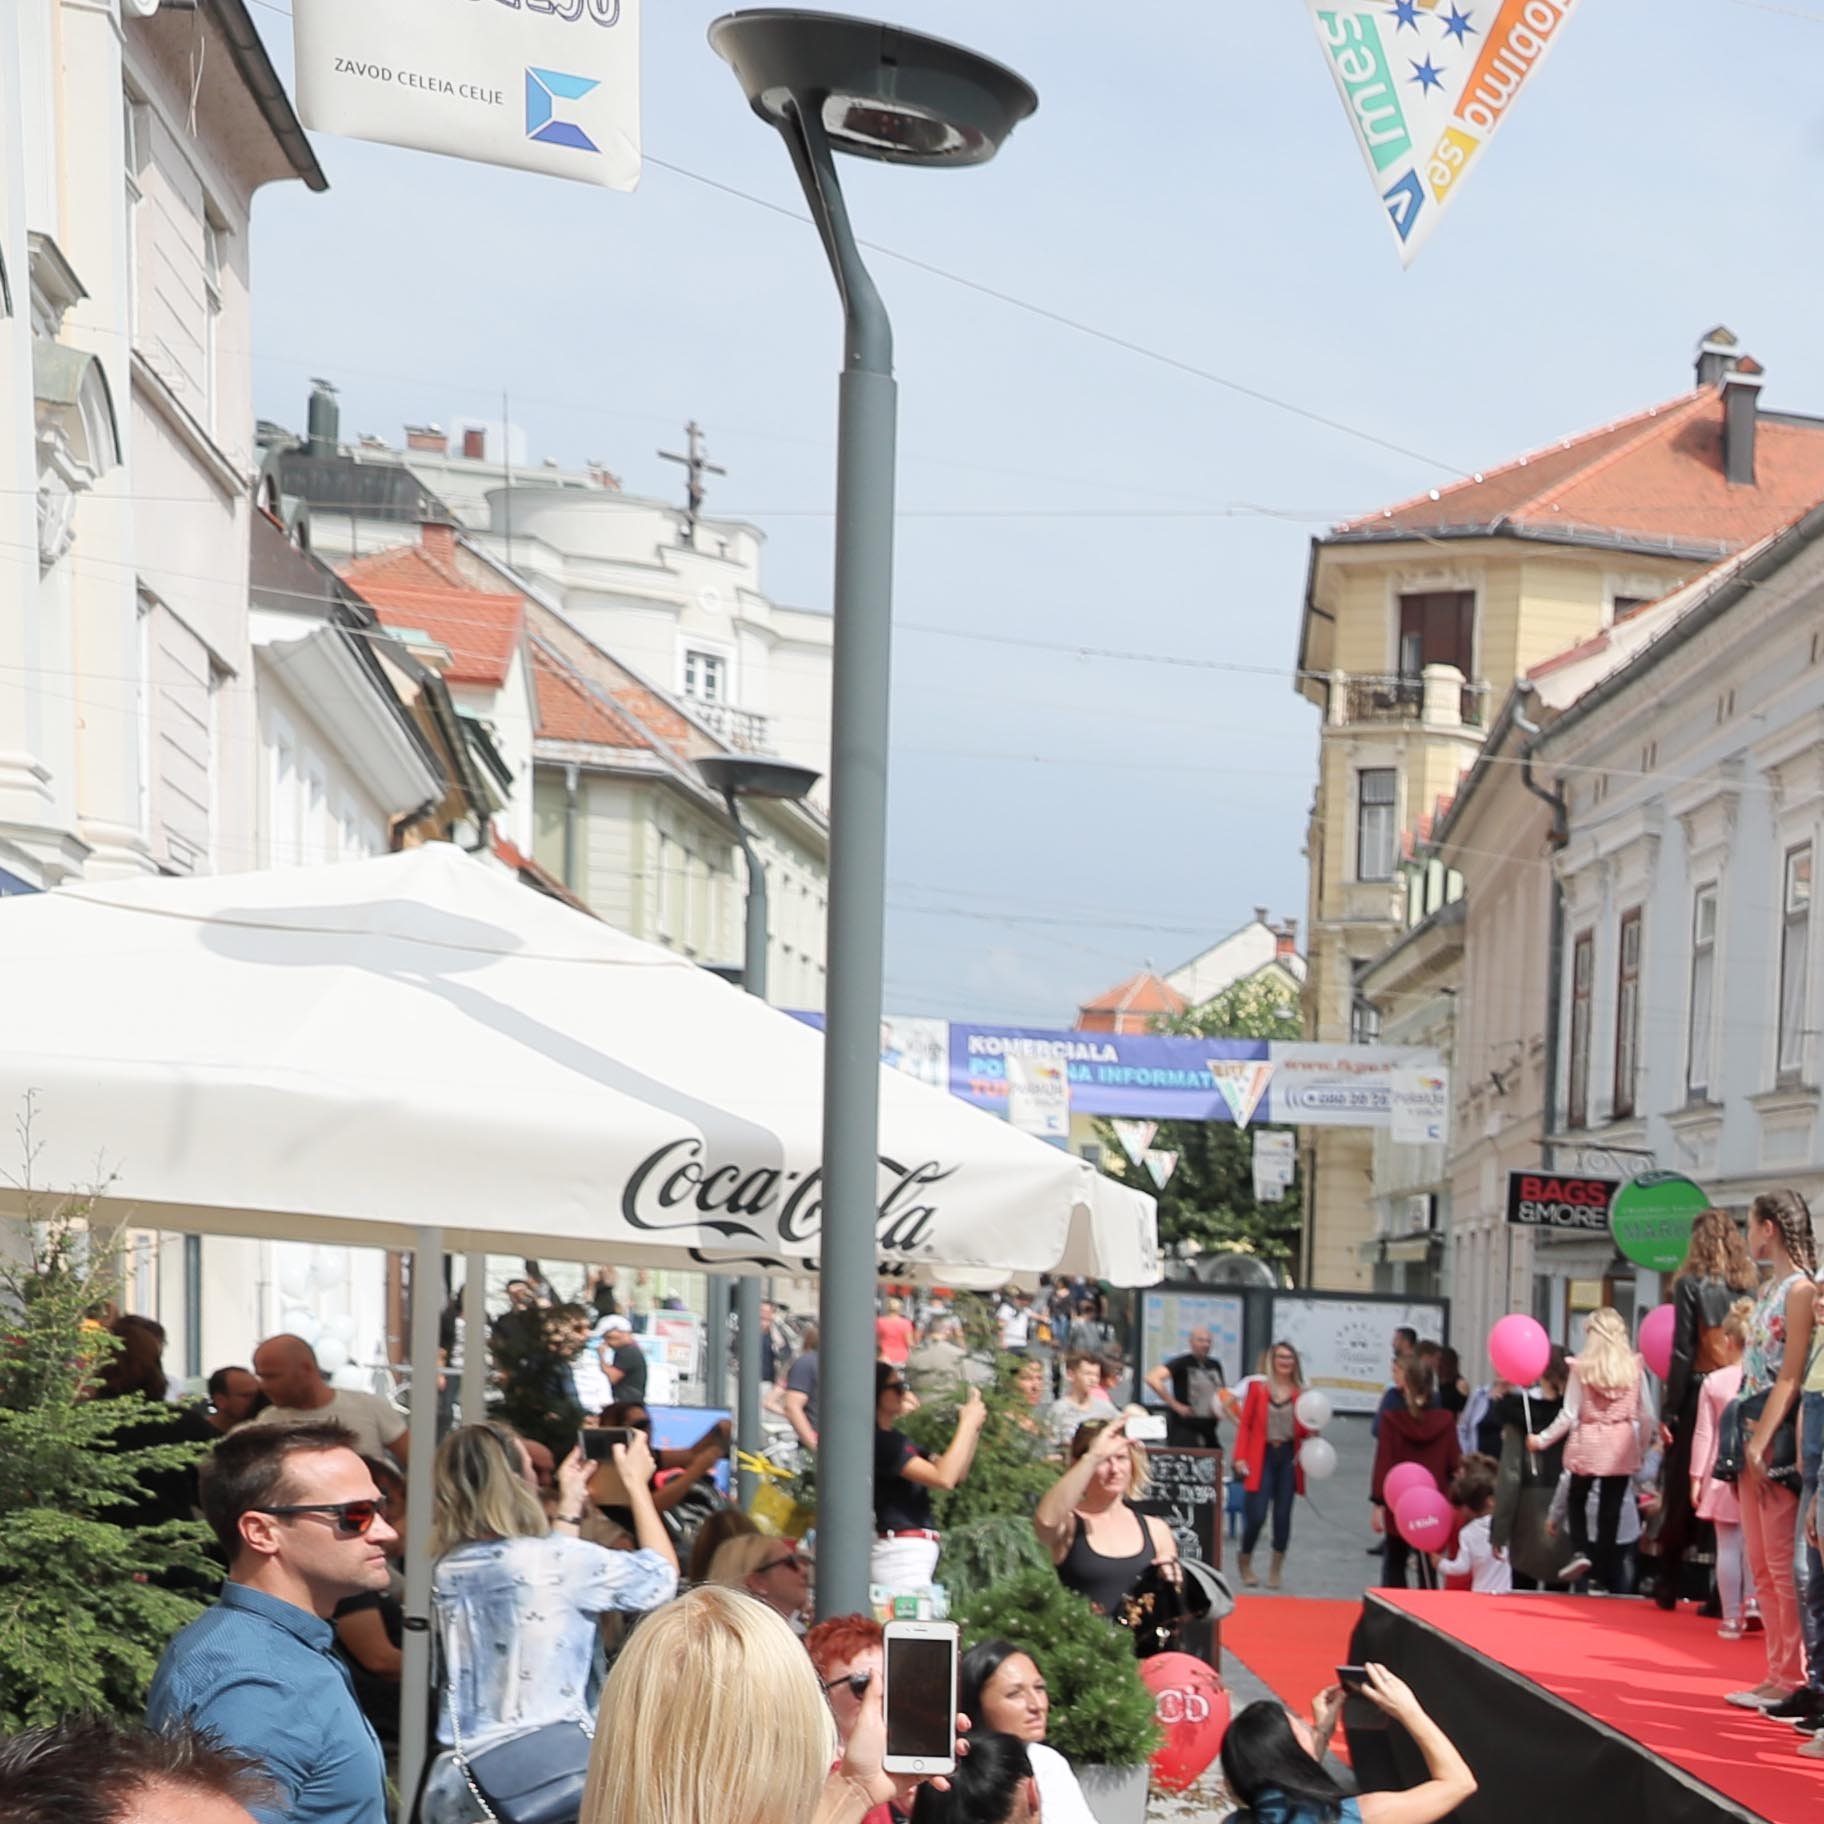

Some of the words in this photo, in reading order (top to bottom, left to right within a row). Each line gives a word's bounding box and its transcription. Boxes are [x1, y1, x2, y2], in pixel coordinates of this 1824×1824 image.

[333, 57, 393, 82] ZAVOD
[397, 70, 455, 96] CELEIA
[458, 82, 505, 105] CELJE
[967, 1034, 1120, 1063] KOMERCIALA
[1097, 1064, 1213, 1089] INFORMAT
[1520, 1175, 1608, 1206] BAGS
[1518, 1200, 1605, 1228] &MORE
